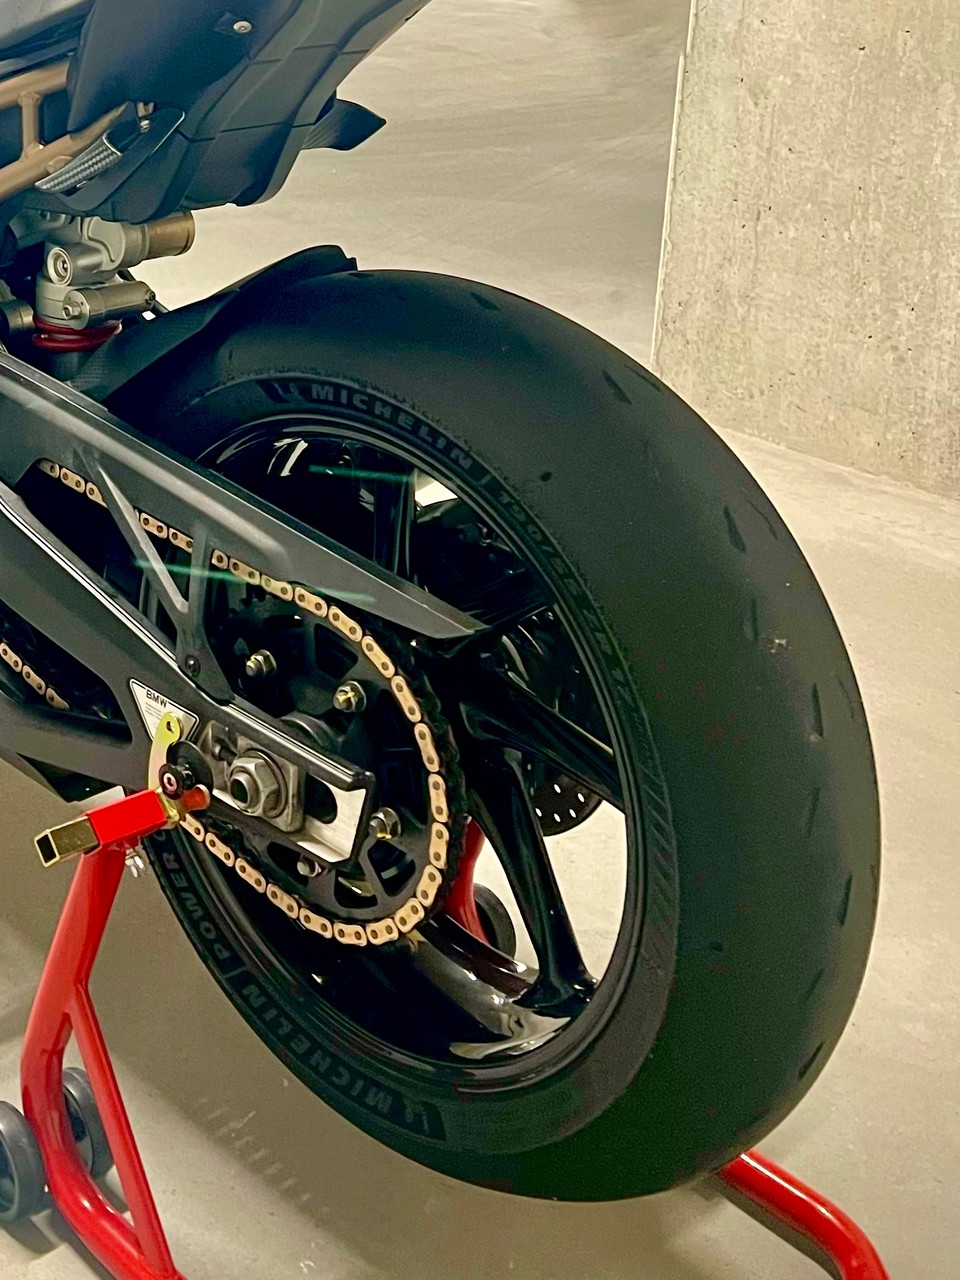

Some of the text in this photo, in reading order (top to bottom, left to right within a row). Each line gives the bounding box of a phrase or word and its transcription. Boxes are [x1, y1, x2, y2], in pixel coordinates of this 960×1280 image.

[311, 384, 473, 469] MICHELIN
[146, 689, 168, 708] BMW
[162, 852, 393, 1112] MICHELIN POWER
